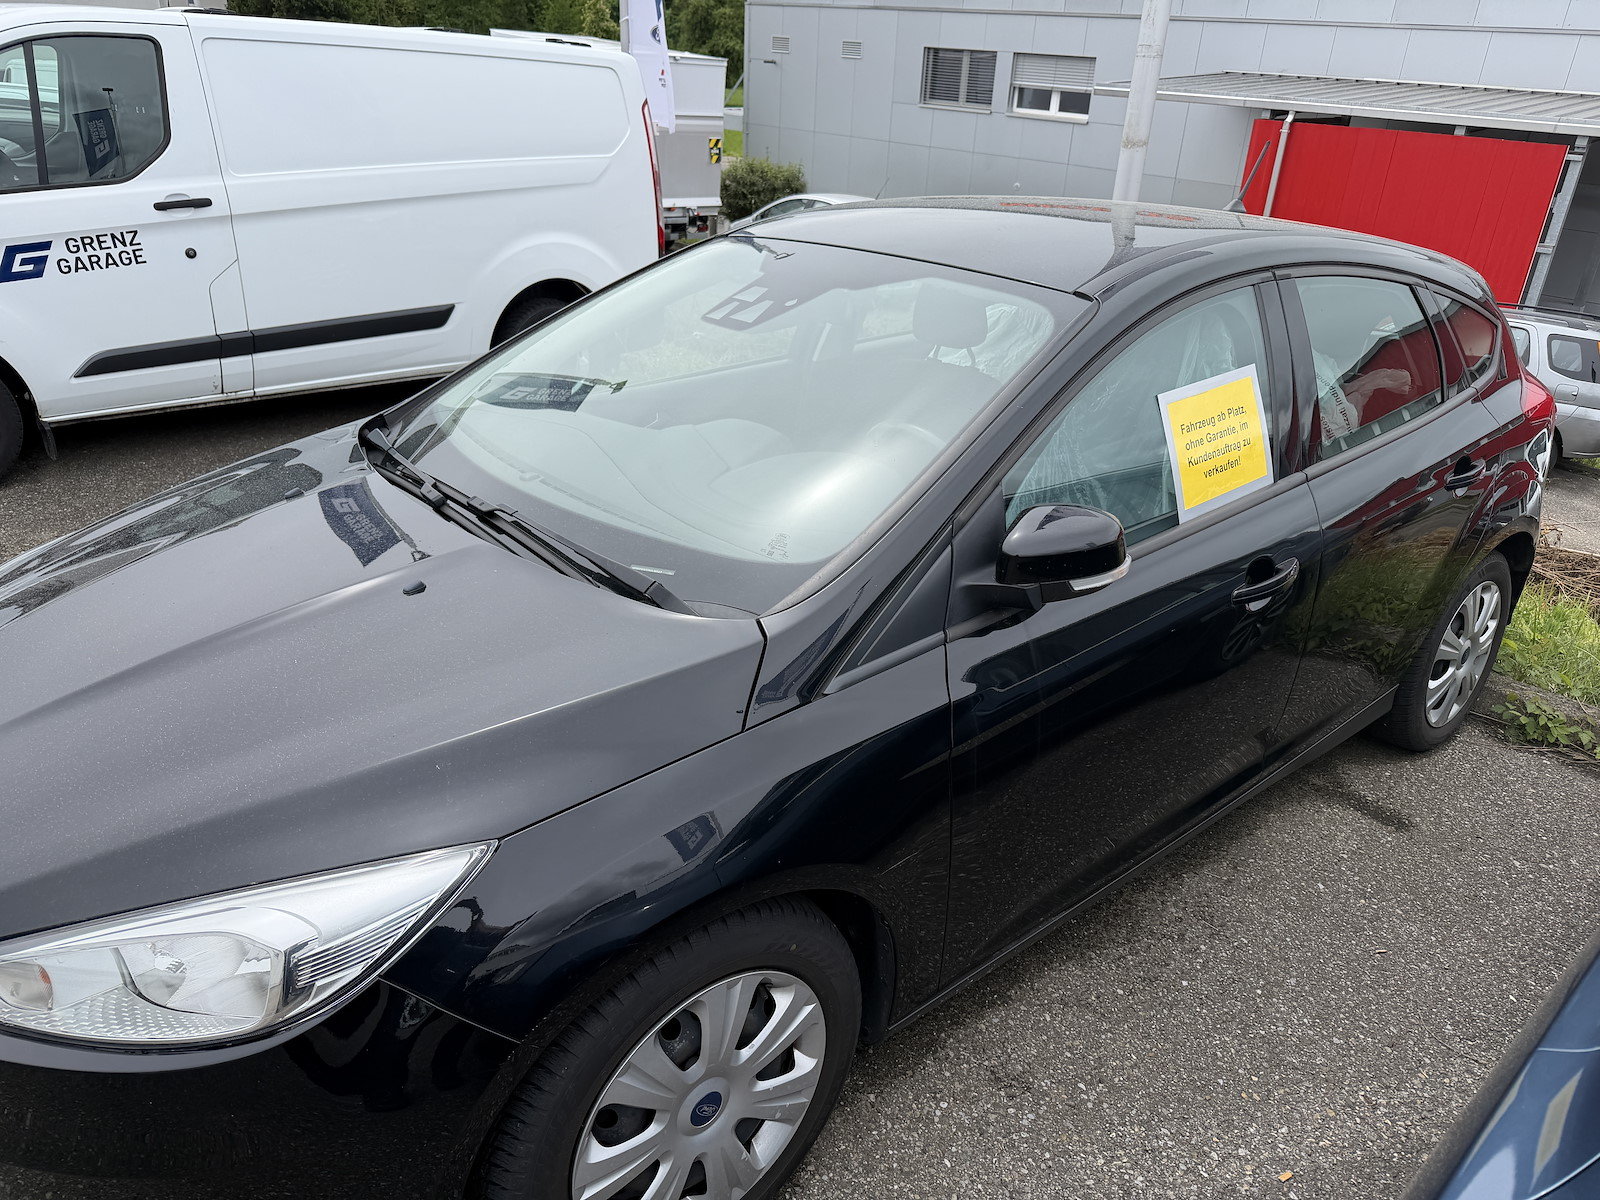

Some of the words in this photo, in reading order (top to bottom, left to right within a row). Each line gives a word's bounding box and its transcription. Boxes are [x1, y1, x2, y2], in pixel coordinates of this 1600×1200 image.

[64, 229, 142, 254] GRENZ
[56, 248, 147, 275] GARAGE
[526, 394, 567, 402] GARAGE
[1180, 416, 1216, 435] Fahrzeug
[1217, 411, 1227, 422] ab
[1227, 405, 1247, 419] Platz,
[1185, 436, 1205, 451] ohne
[1205, 426, 1239, 443] Garantie,
[1239, 420, 1249, 431] im
[1187, 441, 1242, 468] Kundenauftrag
[1242, 437, 1251, 447] zu
[1203, 455, 1242, 479] verkaufen!
